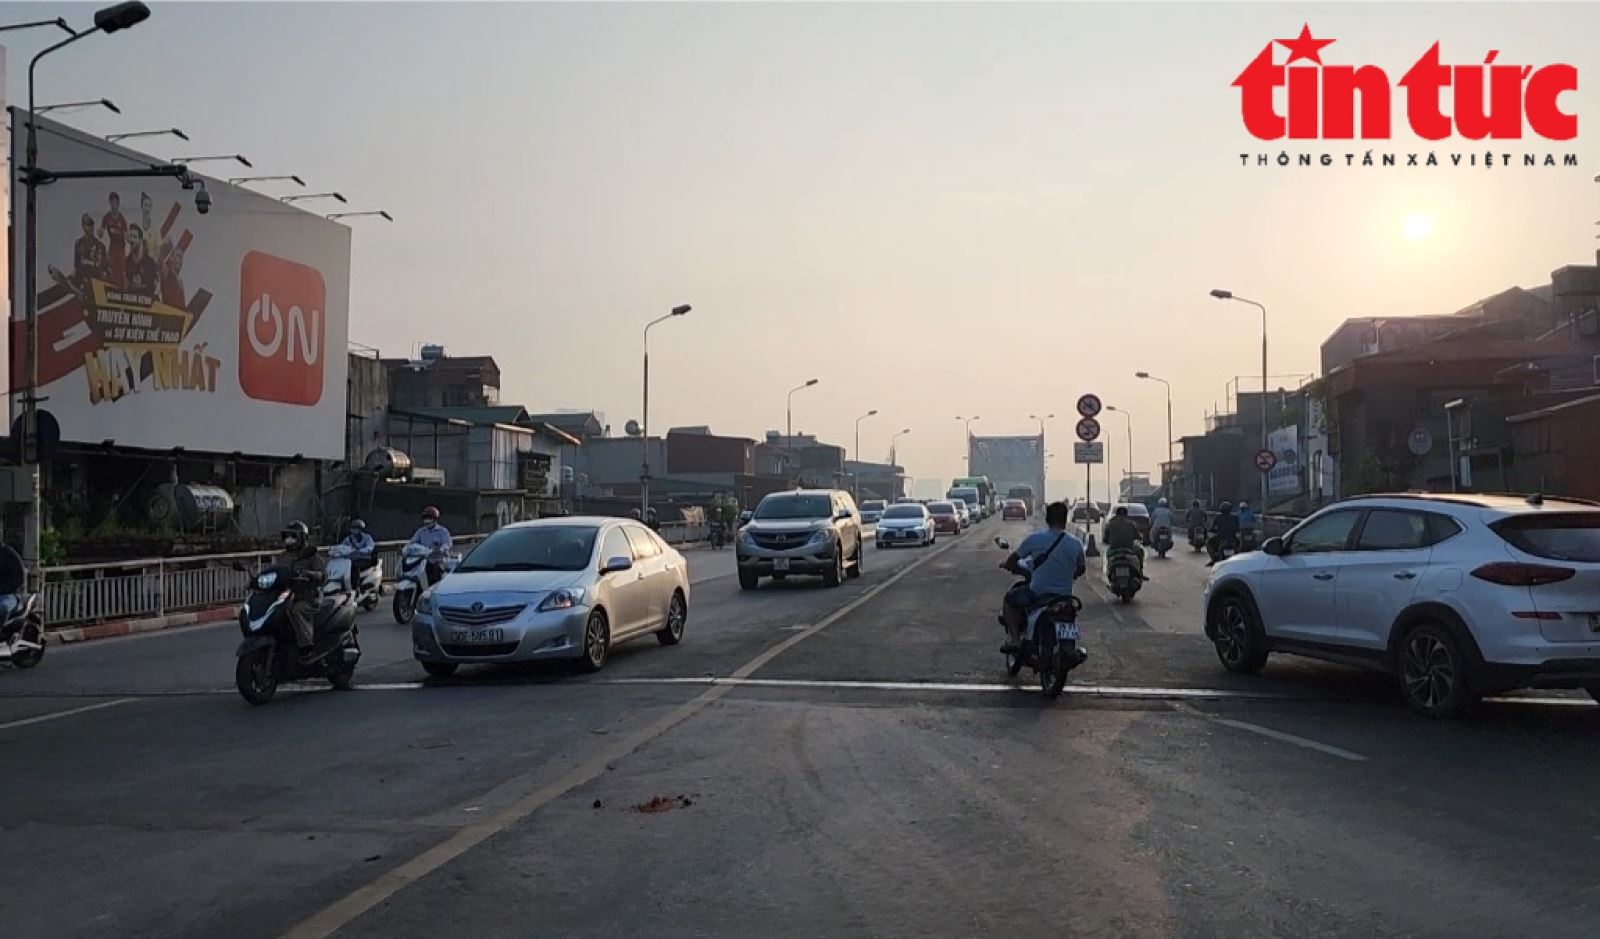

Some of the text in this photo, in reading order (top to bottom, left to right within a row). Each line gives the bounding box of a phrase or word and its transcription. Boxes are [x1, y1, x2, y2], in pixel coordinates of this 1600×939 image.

[246, 293, 320, 366] ON
[85, 341, 221, 405] HAY NHẤT
